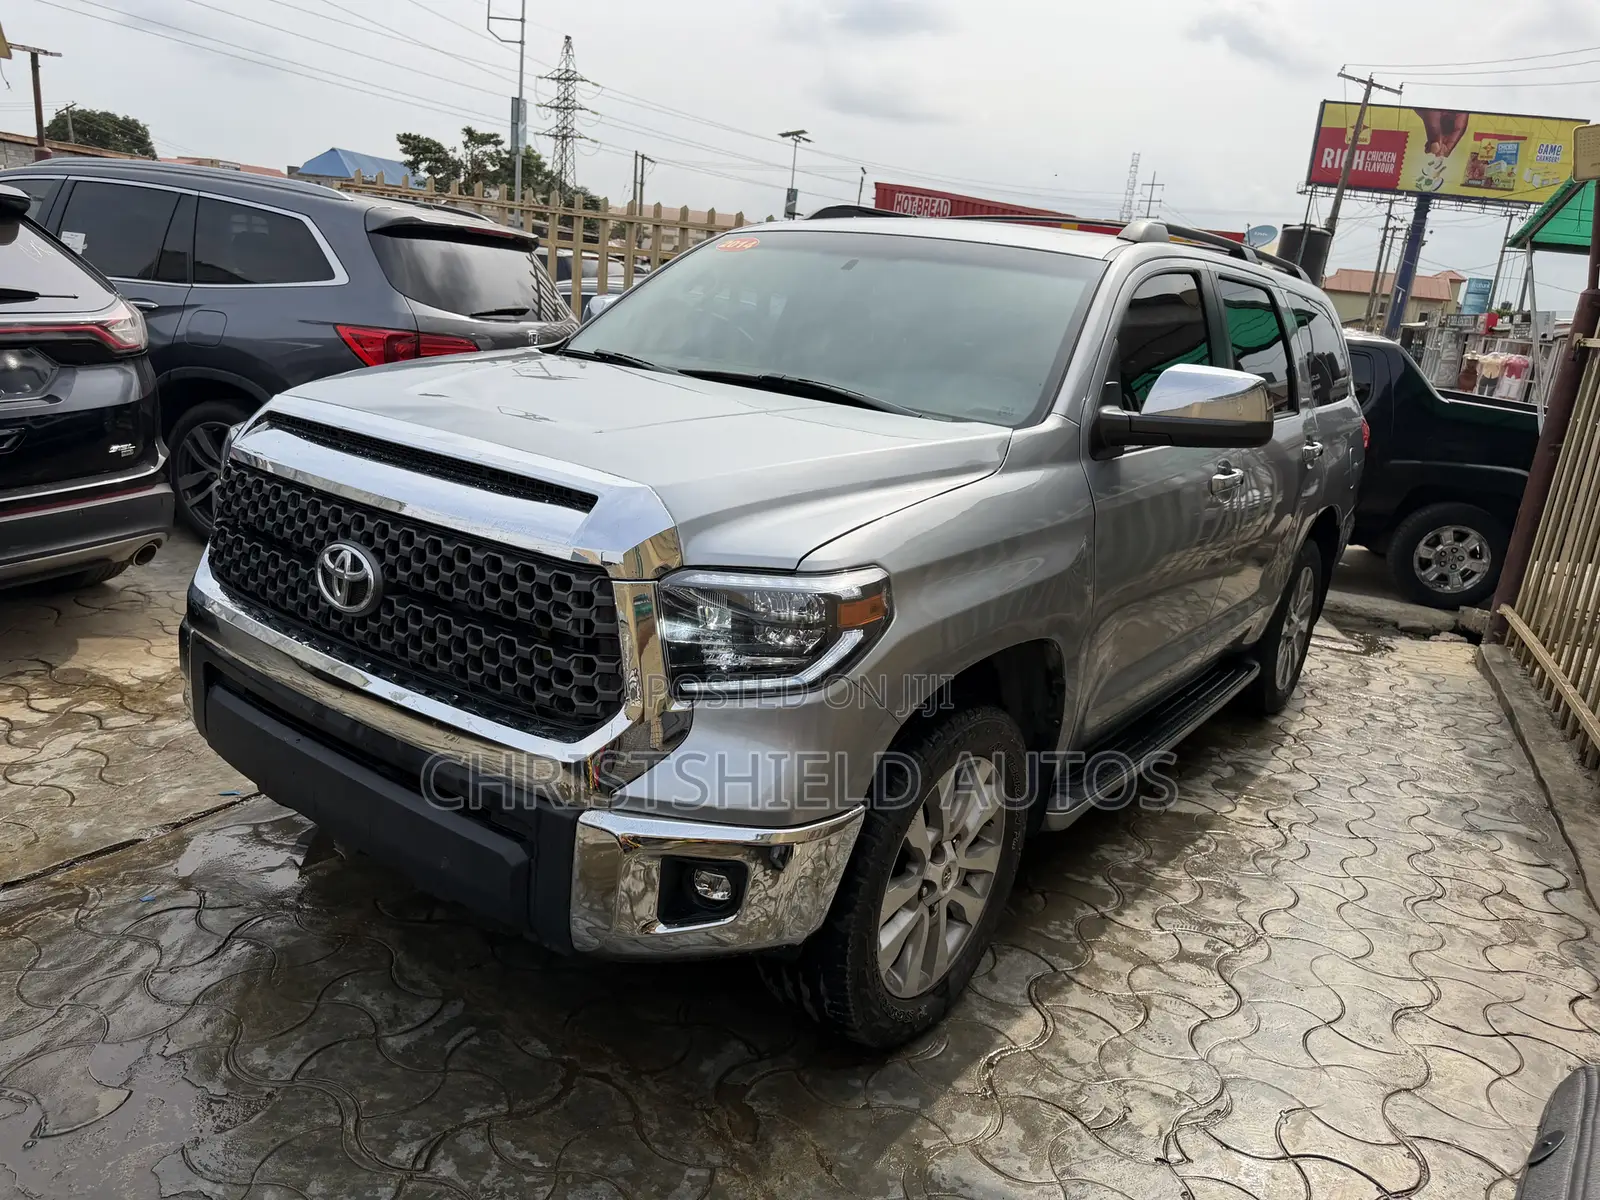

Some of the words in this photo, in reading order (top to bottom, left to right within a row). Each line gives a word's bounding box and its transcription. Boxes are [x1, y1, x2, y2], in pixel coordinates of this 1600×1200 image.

[1367, 151, 1397, 164] CHICKEN
[1364, 161, 1395, 174] FLAVOUR
[917, 197, 950, 217] BREAD
[718, 240, 757, 249] 2014
